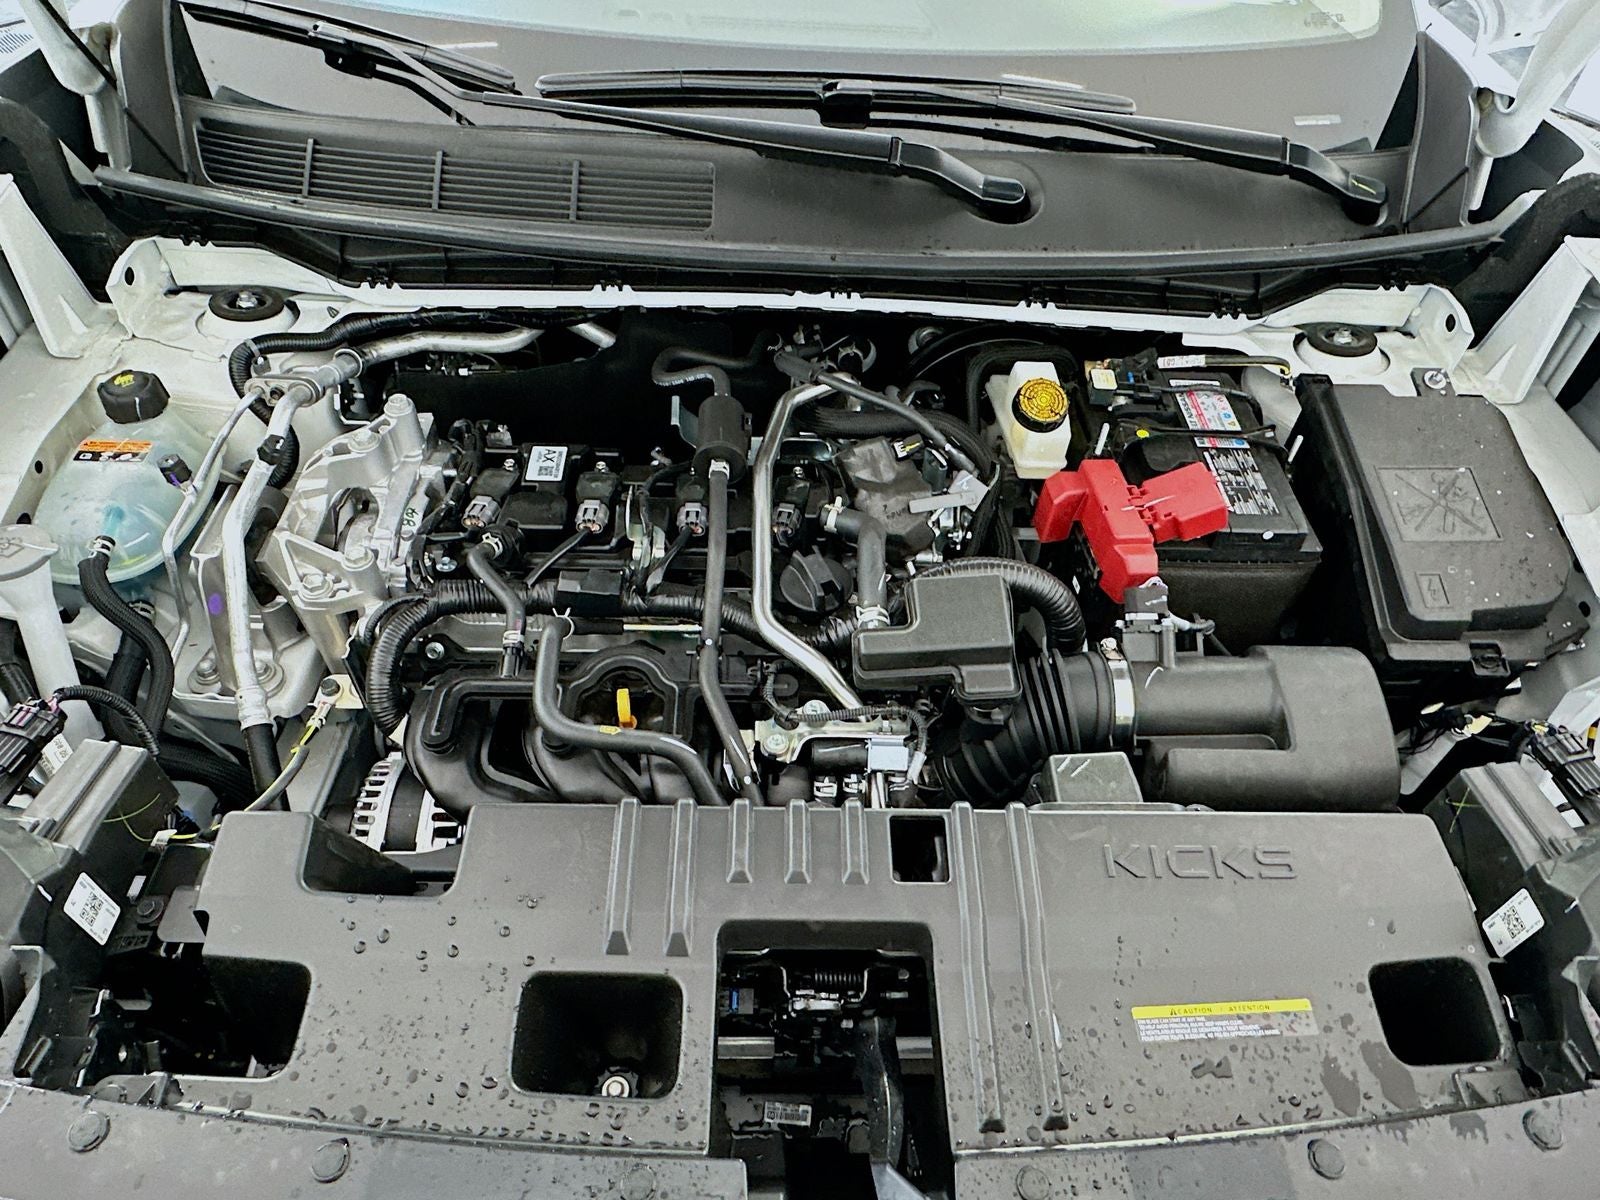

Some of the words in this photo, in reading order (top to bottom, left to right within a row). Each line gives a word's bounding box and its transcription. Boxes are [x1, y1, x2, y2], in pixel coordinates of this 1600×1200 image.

[542, 448, 557, 463] AX
[1103, 843, 1297, 880] KICKS
[1178, 1007, 1212, 1015] CAUTION
[1228, 1004, 1270, 1012] ATTENTION
